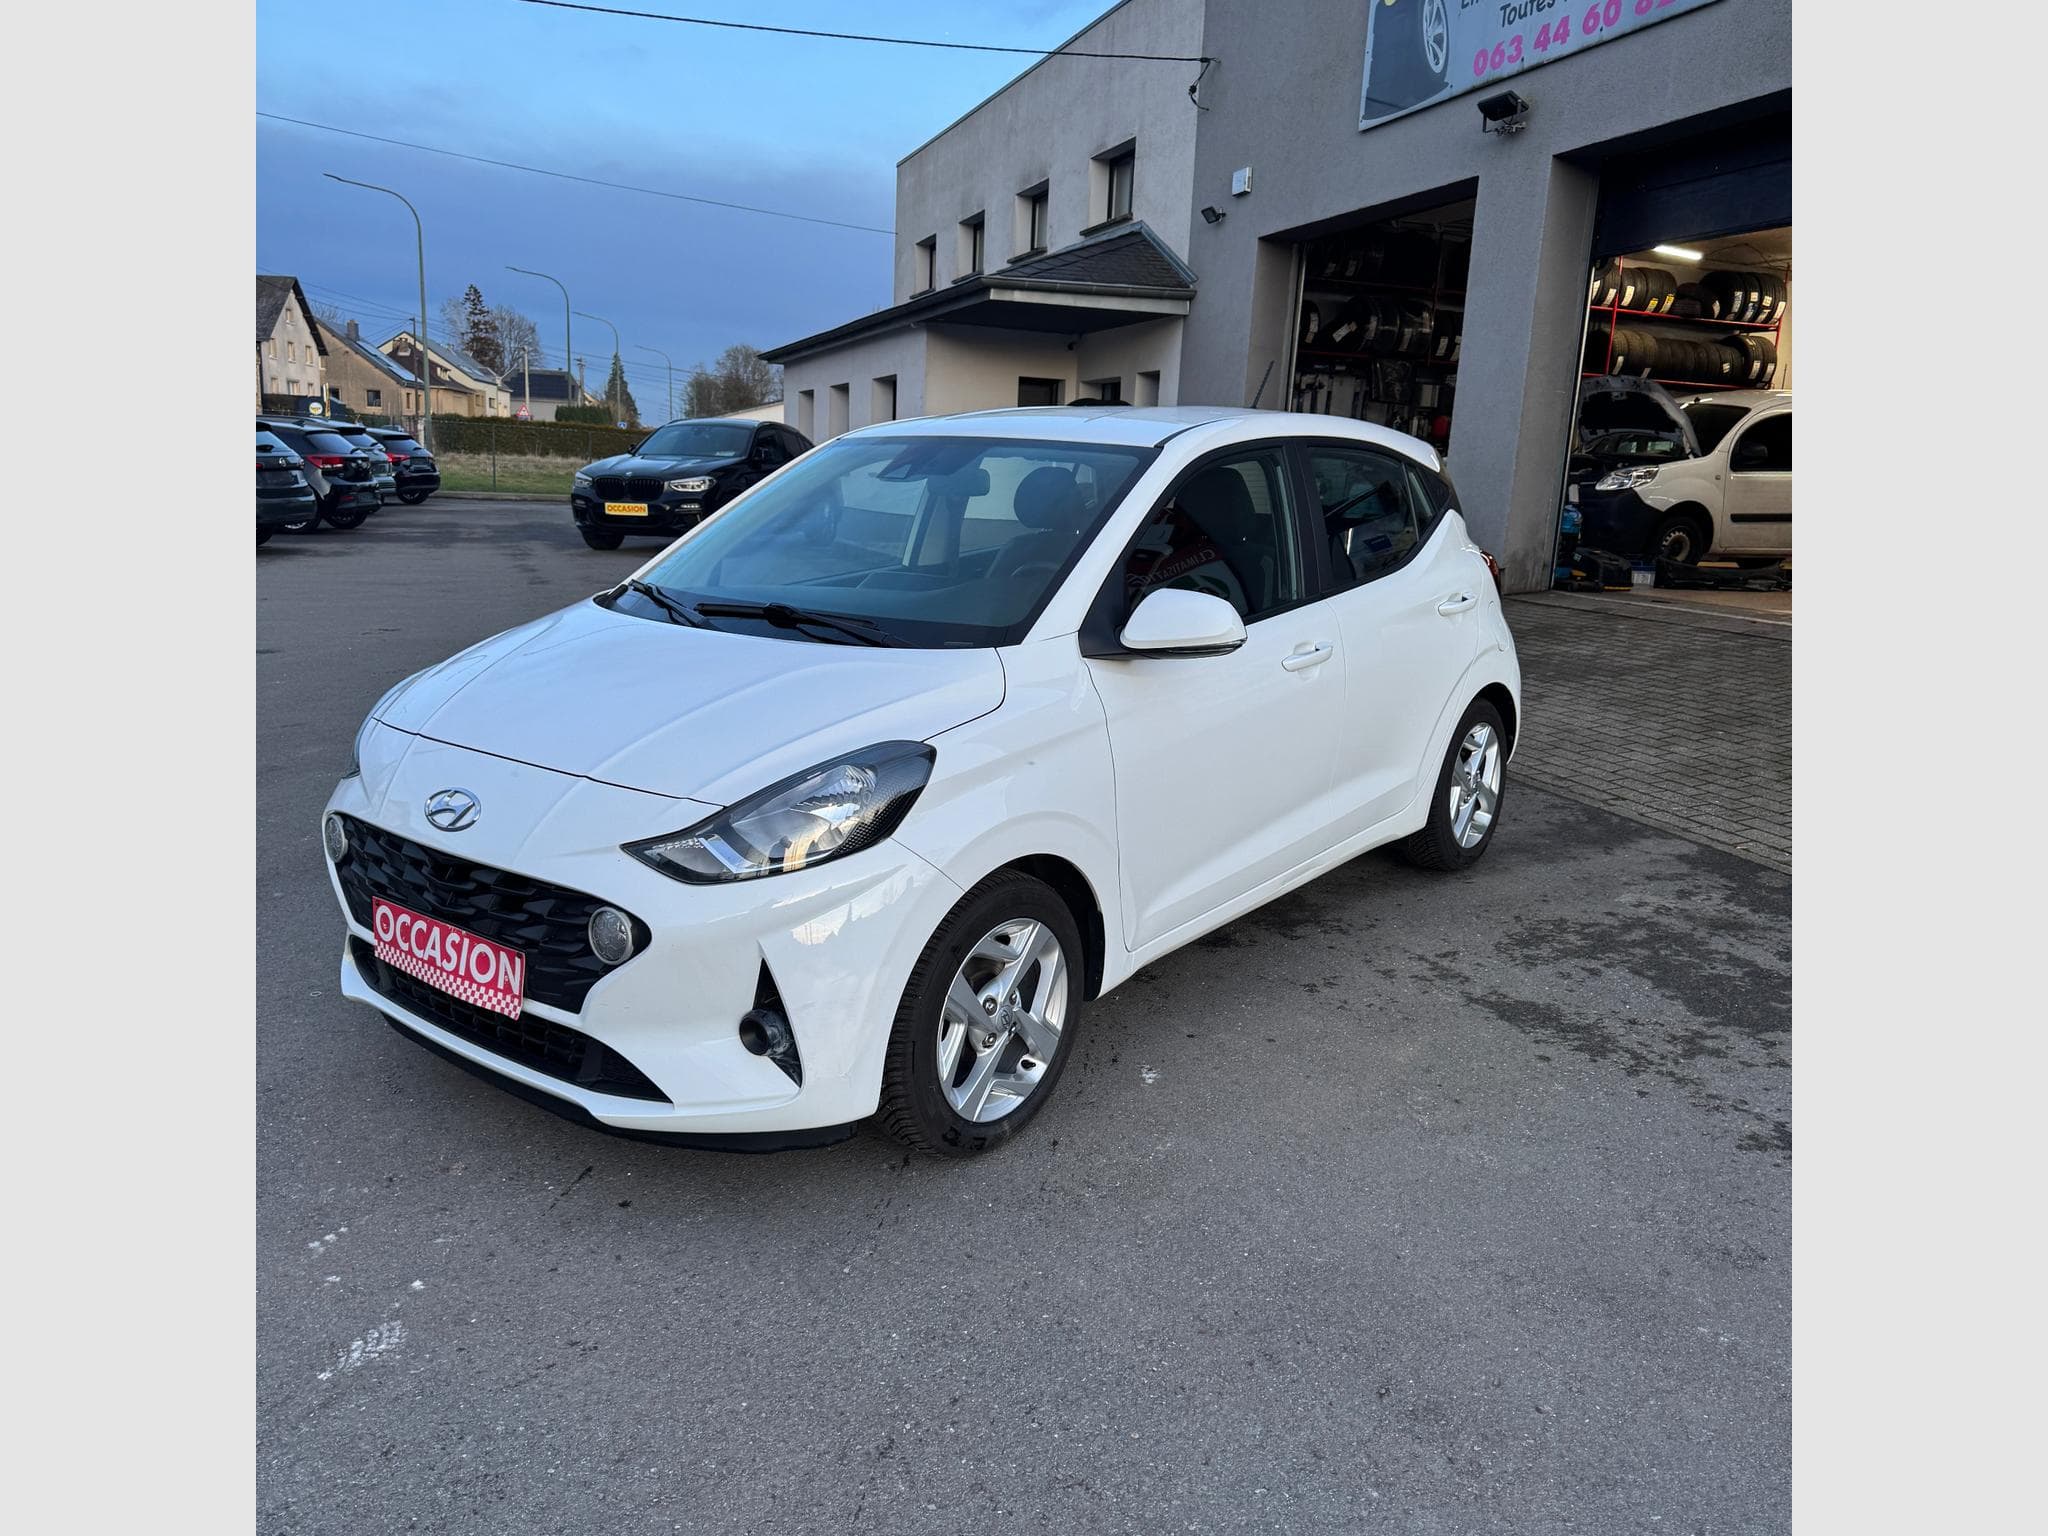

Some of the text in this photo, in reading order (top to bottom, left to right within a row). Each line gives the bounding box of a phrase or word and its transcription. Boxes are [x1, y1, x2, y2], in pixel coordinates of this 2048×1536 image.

[1473, 34, 1523, 77] 063
[1533, 15, 1571, 52] 44
[1582, 0, 1622, 35] 60
[1500, 0, 1555, 28] Toutes
[607, 503, 647, 513] OCCASION
[375, 905, 521, 995] OCCASION
